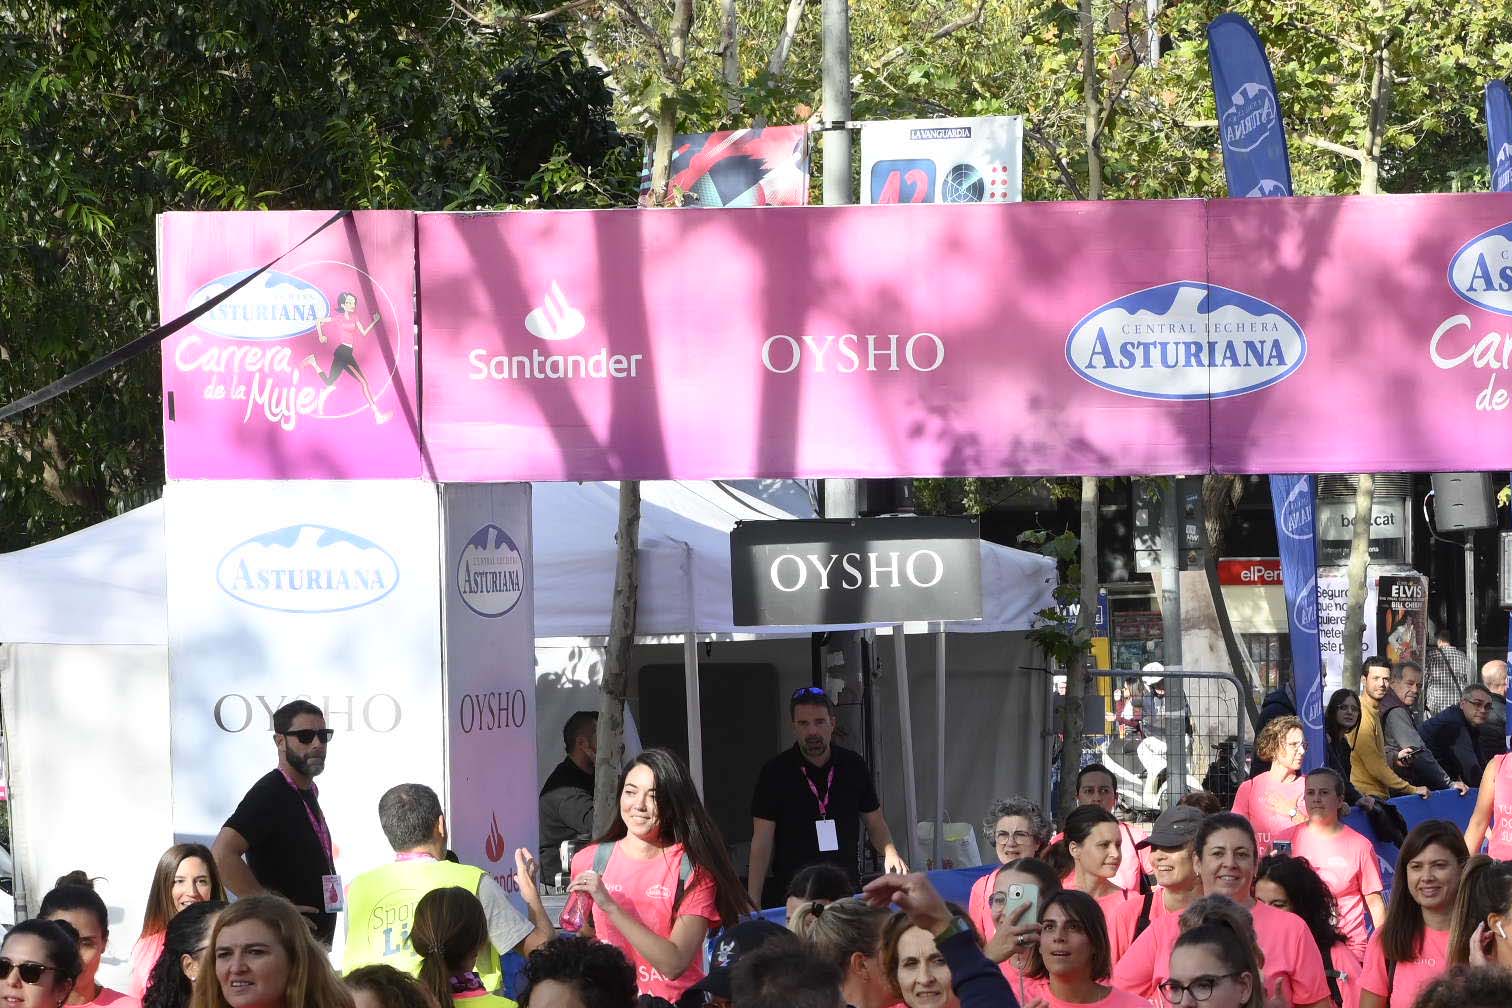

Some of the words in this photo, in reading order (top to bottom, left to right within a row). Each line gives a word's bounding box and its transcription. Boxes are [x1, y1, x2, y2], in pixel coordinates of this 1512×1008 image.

[1085, 325, 1288, 370] ASTURIANA
[1122, 322, 1197, 335] CENTRAL
[1203, 321, 1280, 334] LECHERA
[174, 335, 293, 374] Carrera
[468, 346, 643, 381] Santander
[761, 332, 946, 374] OYSHO
[203, 376, 226, 400] de
[231, 376, 247, 401] la
[243, 368, 337, 431] Mujer
[1475, 372, 1510, 412] de
[232, 556, 386, 591] ASTURIANA
[462, 556, 521, 595] ASTURIANA
[769, 548, 945, 592] OYSHO
[1391, 585, 1422, 598] ELVIS
[1319, 641, 1337, 652] este
[213, 692, 402, 735] OYHO
[460, 688, 527, 735] OYSHO
